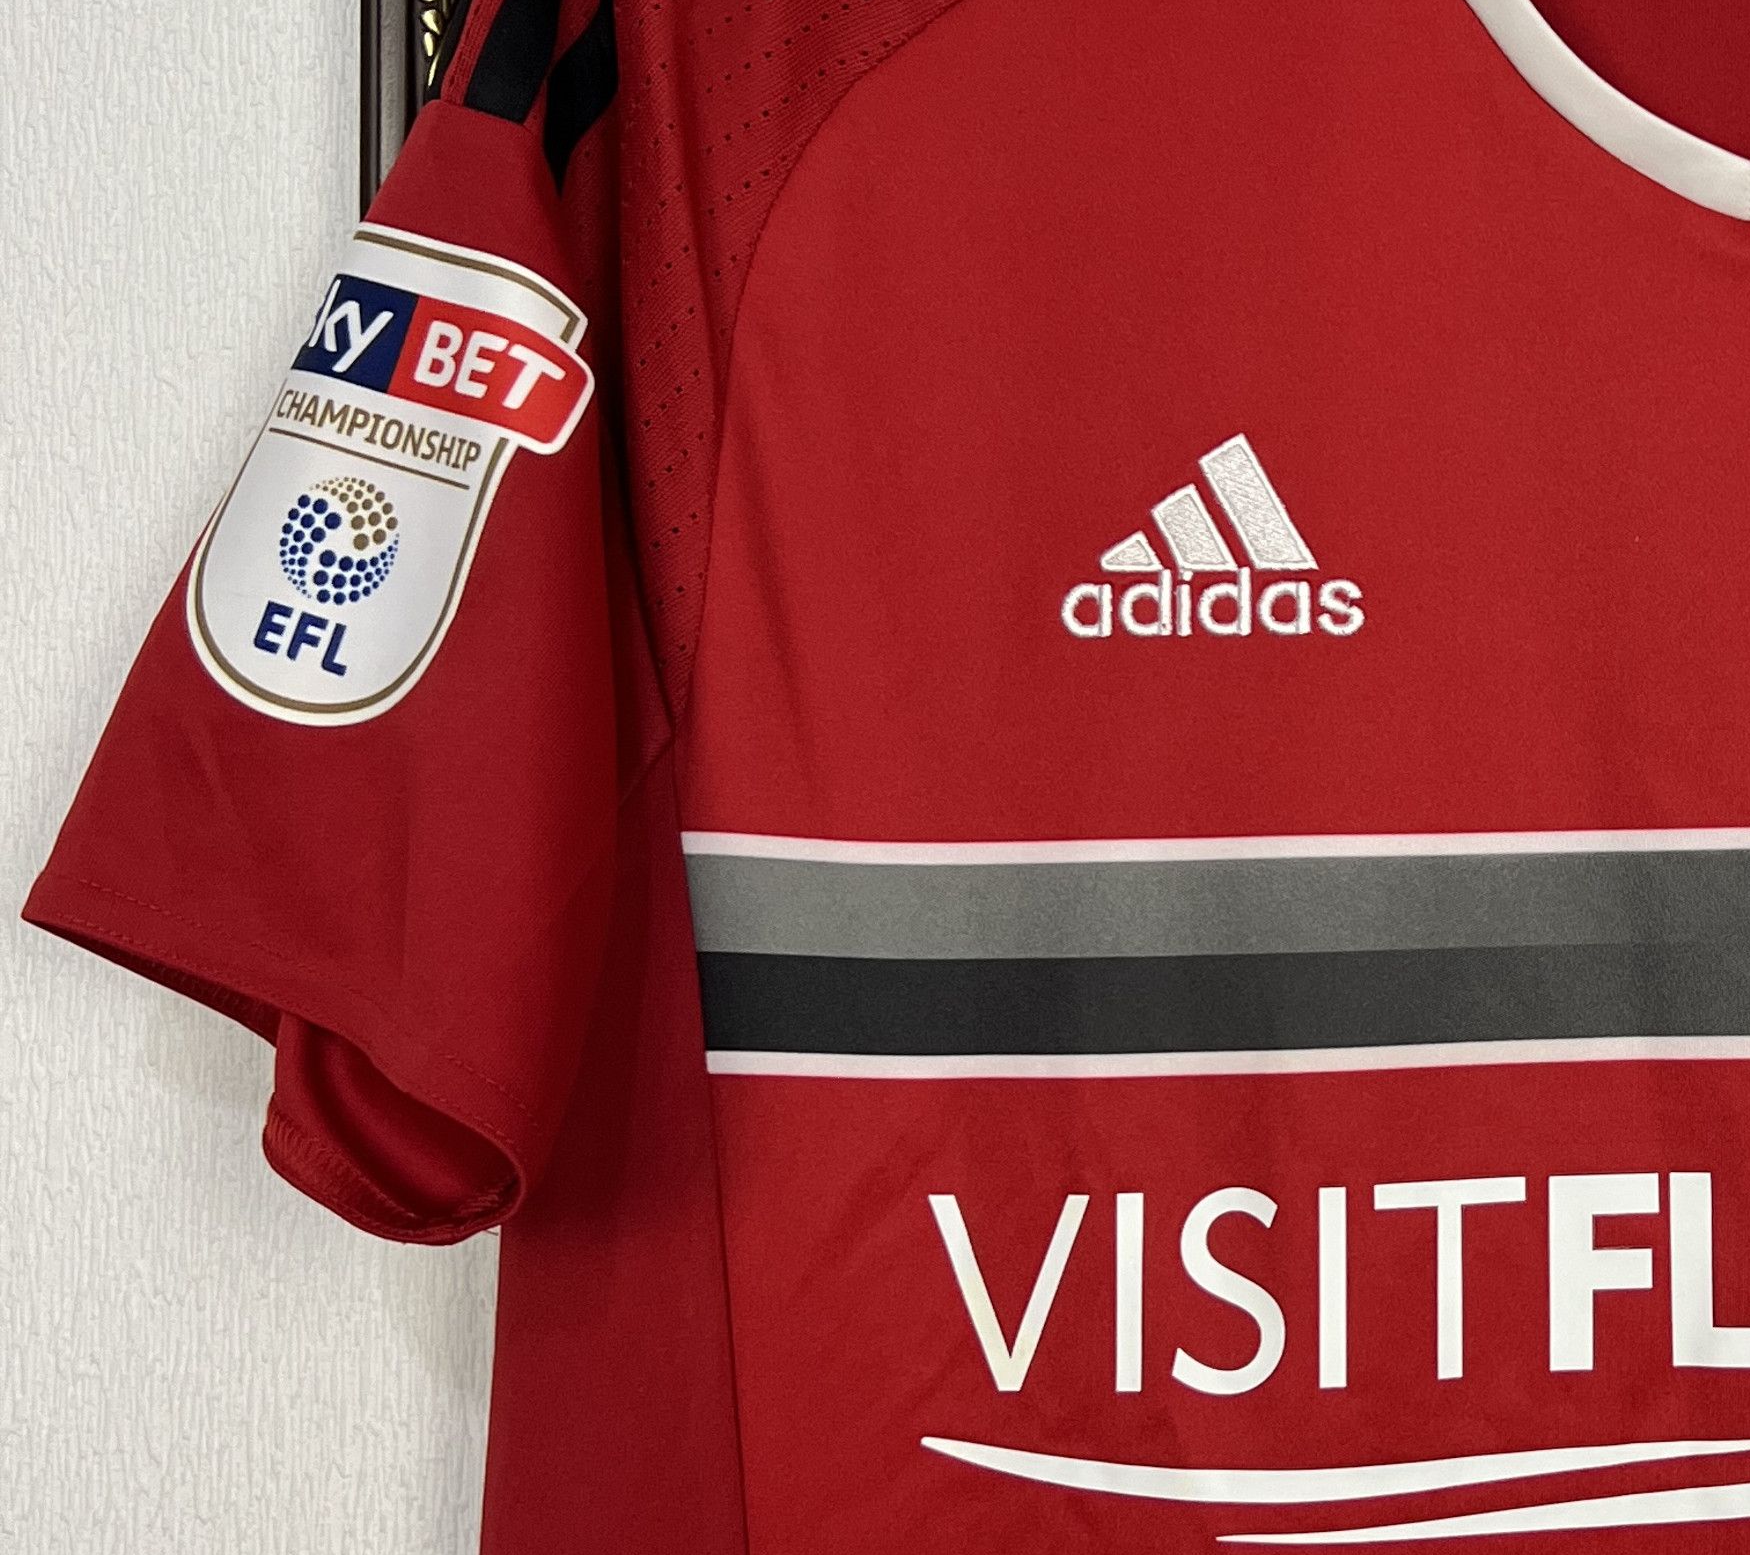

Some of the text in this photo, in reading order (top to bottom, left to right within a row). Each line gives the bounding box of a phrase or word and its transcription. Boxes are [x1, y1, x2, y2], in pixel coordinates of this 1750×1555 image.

[308, 278, 567, 411] ky BET
[276, 389, 482, 472] CHAMPIONSHIP
[253, 599, 349, 677] EFL
[1060, 567, 1367, 638] adidas
